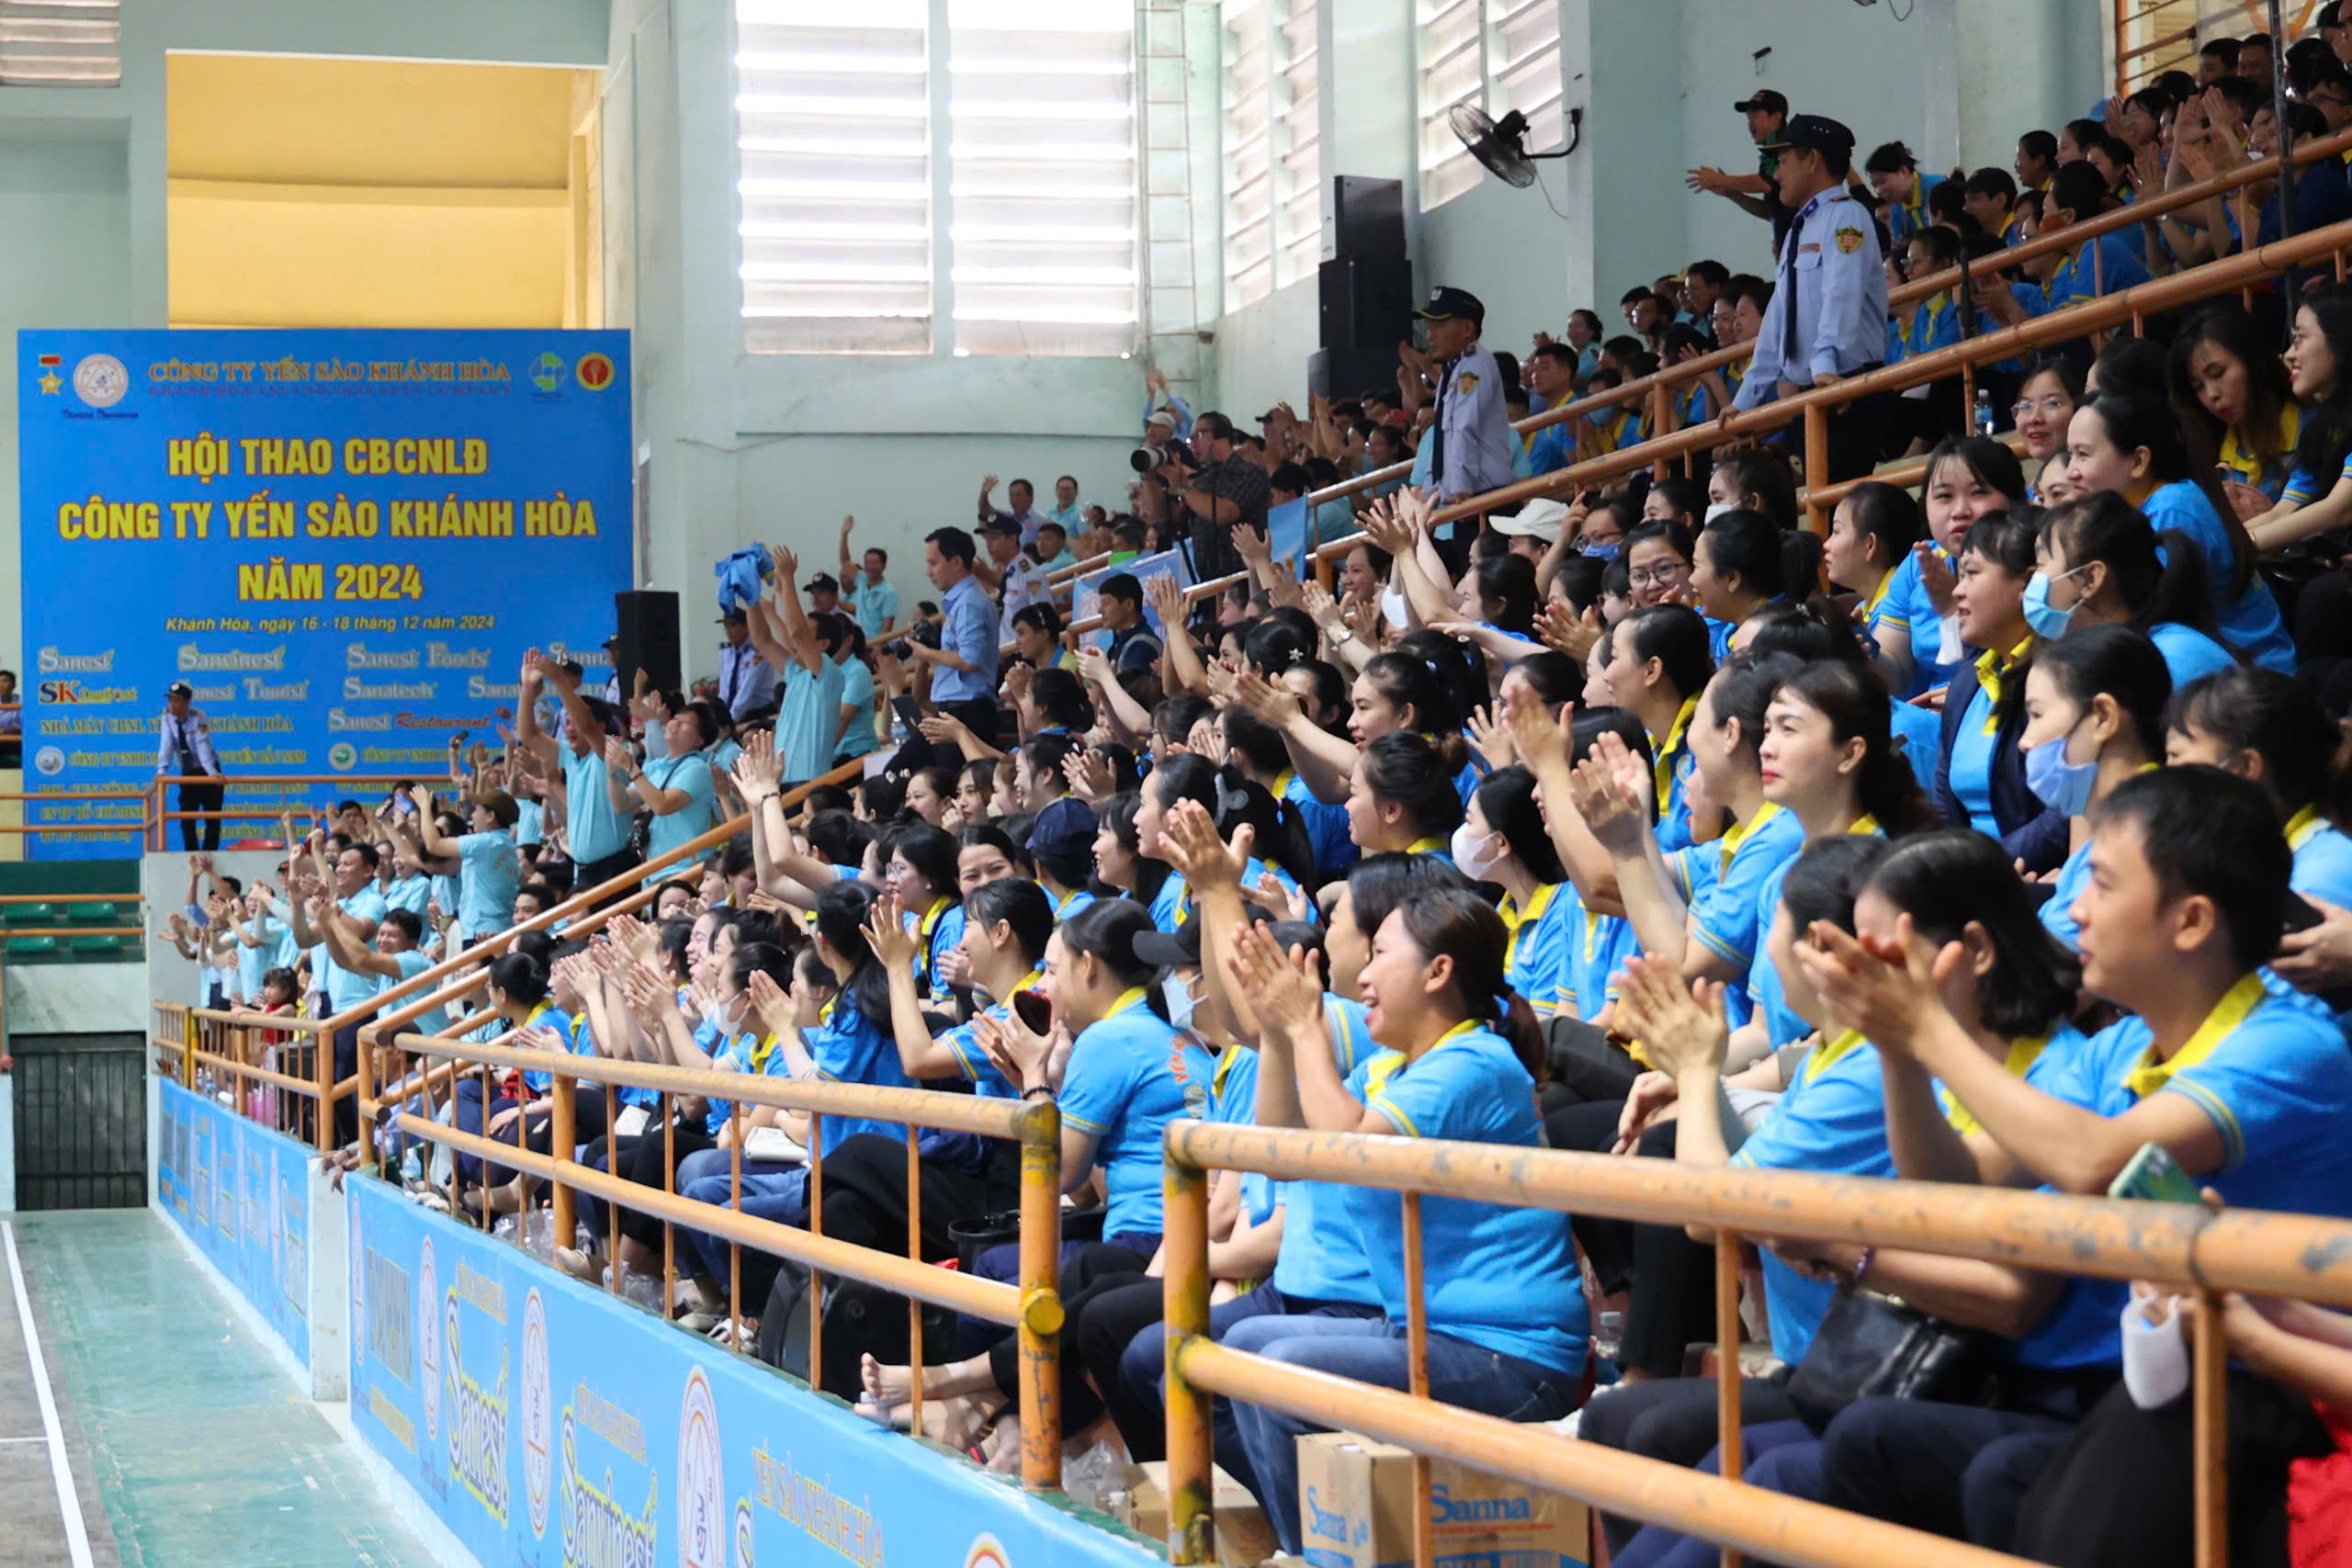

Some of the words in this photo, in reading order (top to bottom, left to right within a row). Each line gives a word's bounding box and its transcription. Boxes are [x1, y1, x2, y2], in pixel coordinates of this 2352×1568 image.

[149, 357, 219, 382] CÔNG
[221, 362, 255, 381] TY
[260, 355, 311, 381] YẾN
[315, 355, 364, 381] SÀO
[368, 357, 455, 381] KHÁNH
[458, 357, 511, 381] HÒA
[167, 431, 230, 484] HỘI
[240, 438, 333, 476] THAO
[344, 437, 489, 476] CBCNLĐ
[58, 494, 161, 540] CÔNG
[170, 502, 213, 539] TY
[223, 489, 296, 538] YẾN
[306, 492, 379, 537] SÀO
[390, 491, 514, 537] KHÁNH
[524, 490, 598, 537] HÒA
[236, 555, 323, 601] NĂM
[334, 562, 424, 601] 2024
[165, 616, 216, 631] Khánh
[258, 617, 297, 634] ngày
[300, 617, 319, 630] 16
[332, 617, 349, 630] 18
[354, 616, 397, 633] tháng
[402, 616, 420, 629] 12
[423, 616, 455, 629] năm
[459, 615, 496, 629] 2024
[38, 645, 115, 674] Sanest
[177, 642, 286, 671] Sanvinest
[345, 641, 420, 671] Sanest
[426, 641, 492, 668] Foods
[243, 676, 310, 701] Tourist
[343, 676, 437, 700] Sanatech
[328, 706, 391, 732] Sanest
[395, 712, 491, 728] Restaurant
[447, 1286, 509, 1529] Sanest
[1430, 1483, 1531, 1524] Sanna
